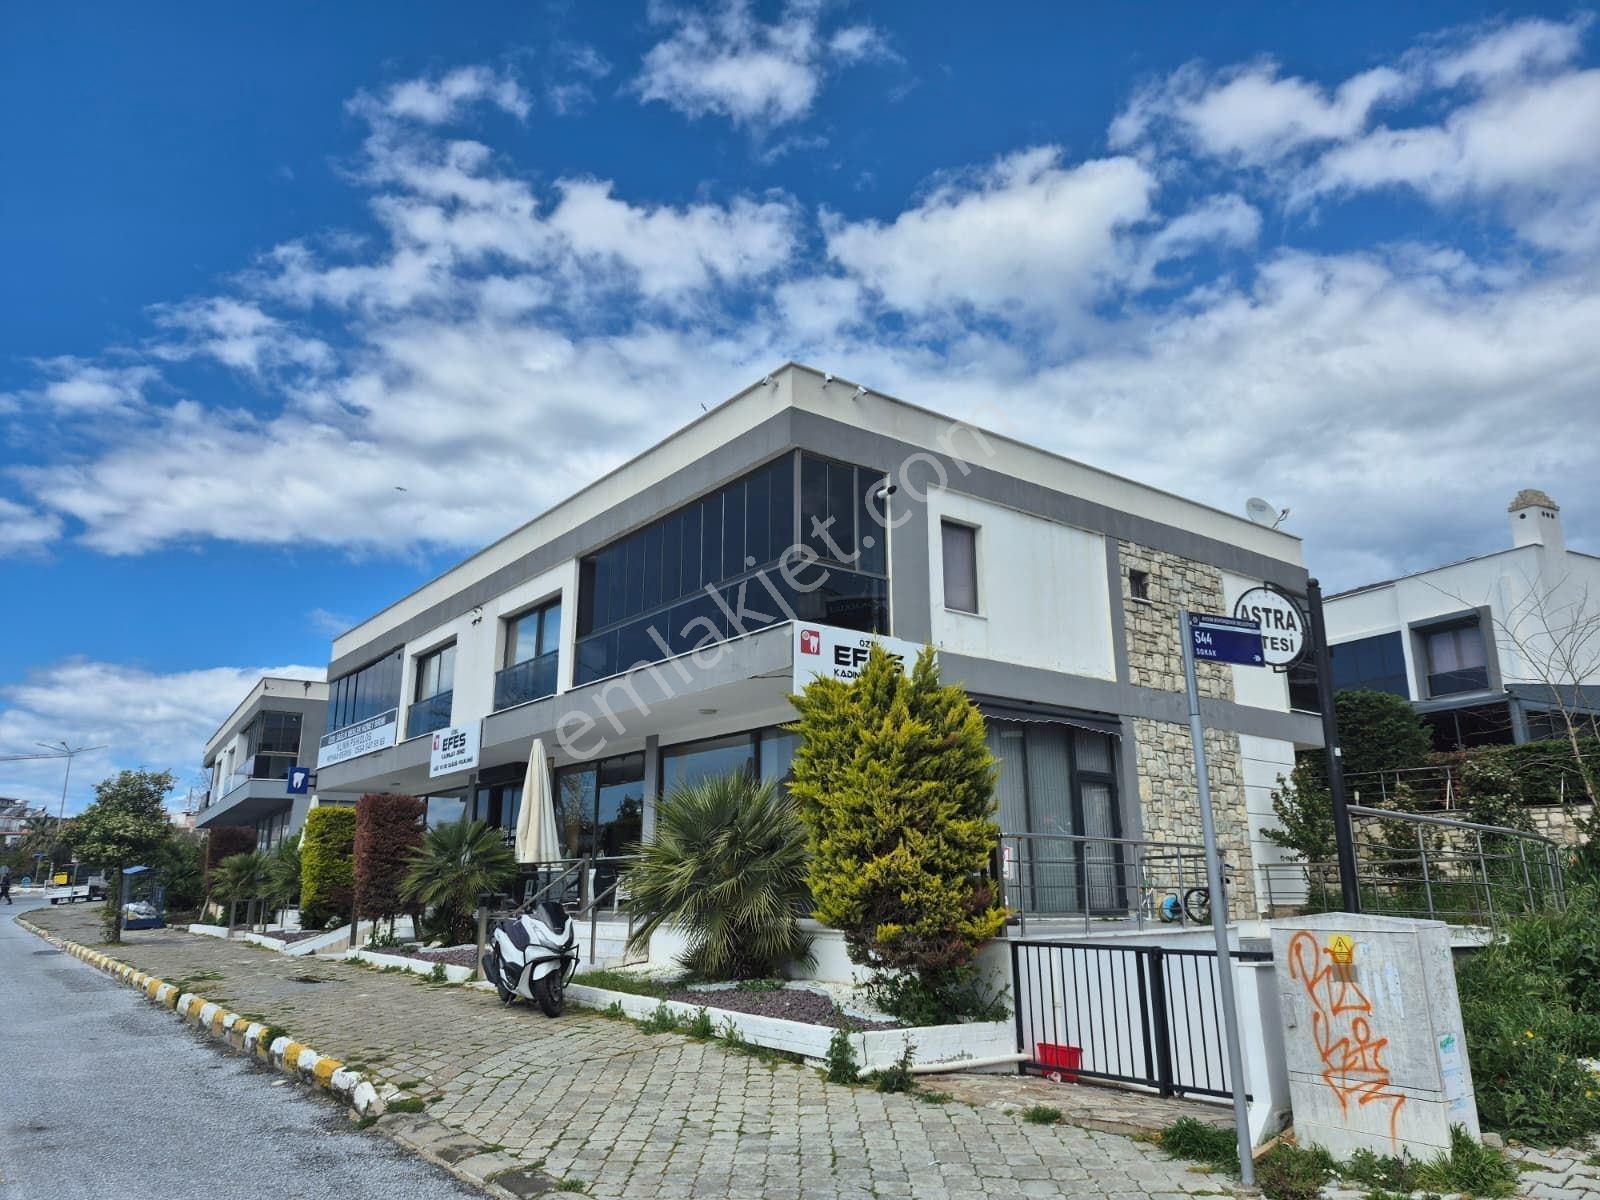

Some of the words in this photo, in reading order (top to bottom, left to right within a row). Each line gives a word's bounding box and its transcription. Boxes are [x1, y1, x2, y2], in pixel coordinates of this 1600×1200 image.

[1241, 604, 1297, 632] ASTRA
[1194, 631, 1213, 645] 544
[442, 733, 467, 752] EFES
